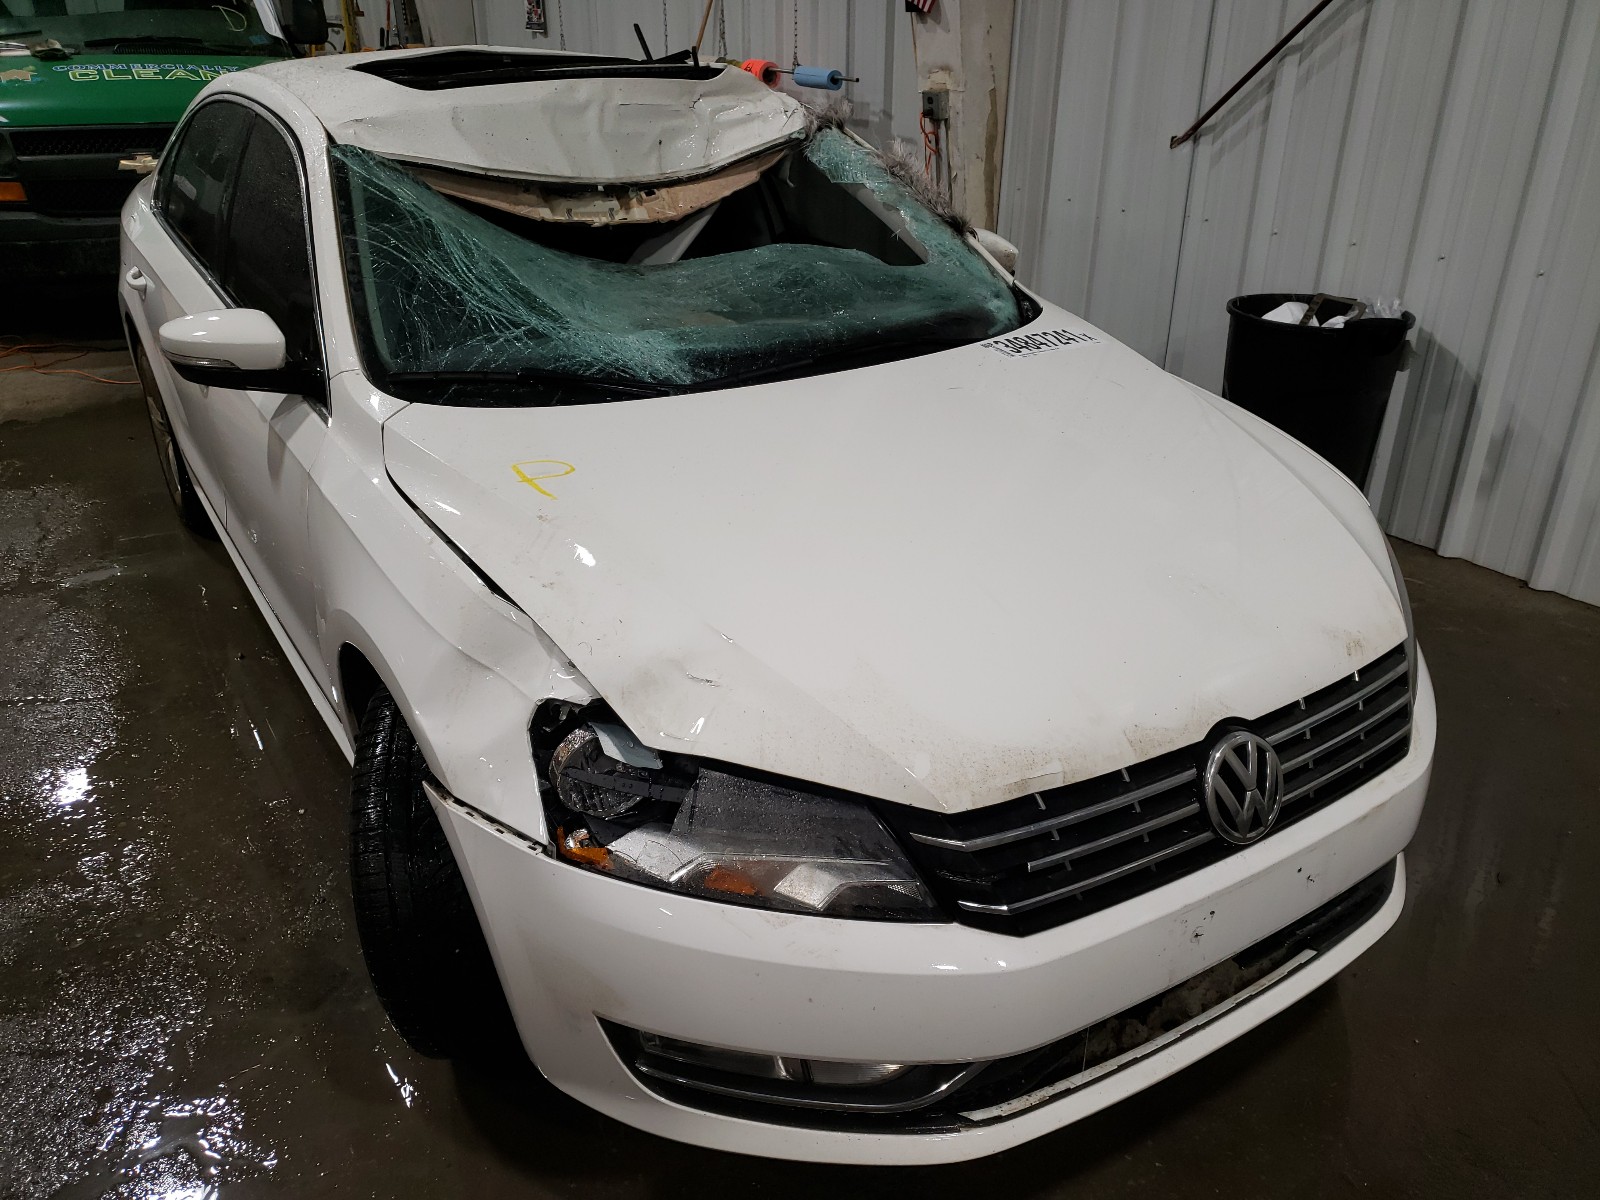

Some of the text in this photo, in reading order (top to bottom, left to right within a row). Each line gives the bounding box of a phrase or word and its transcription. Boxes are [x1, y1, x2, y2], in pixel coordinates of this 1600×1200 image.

[52, 63, 240, 72] COMMERCIALLY
[993, 329, 1088, 354] 34847241
[511, 459, 576, 500] P
